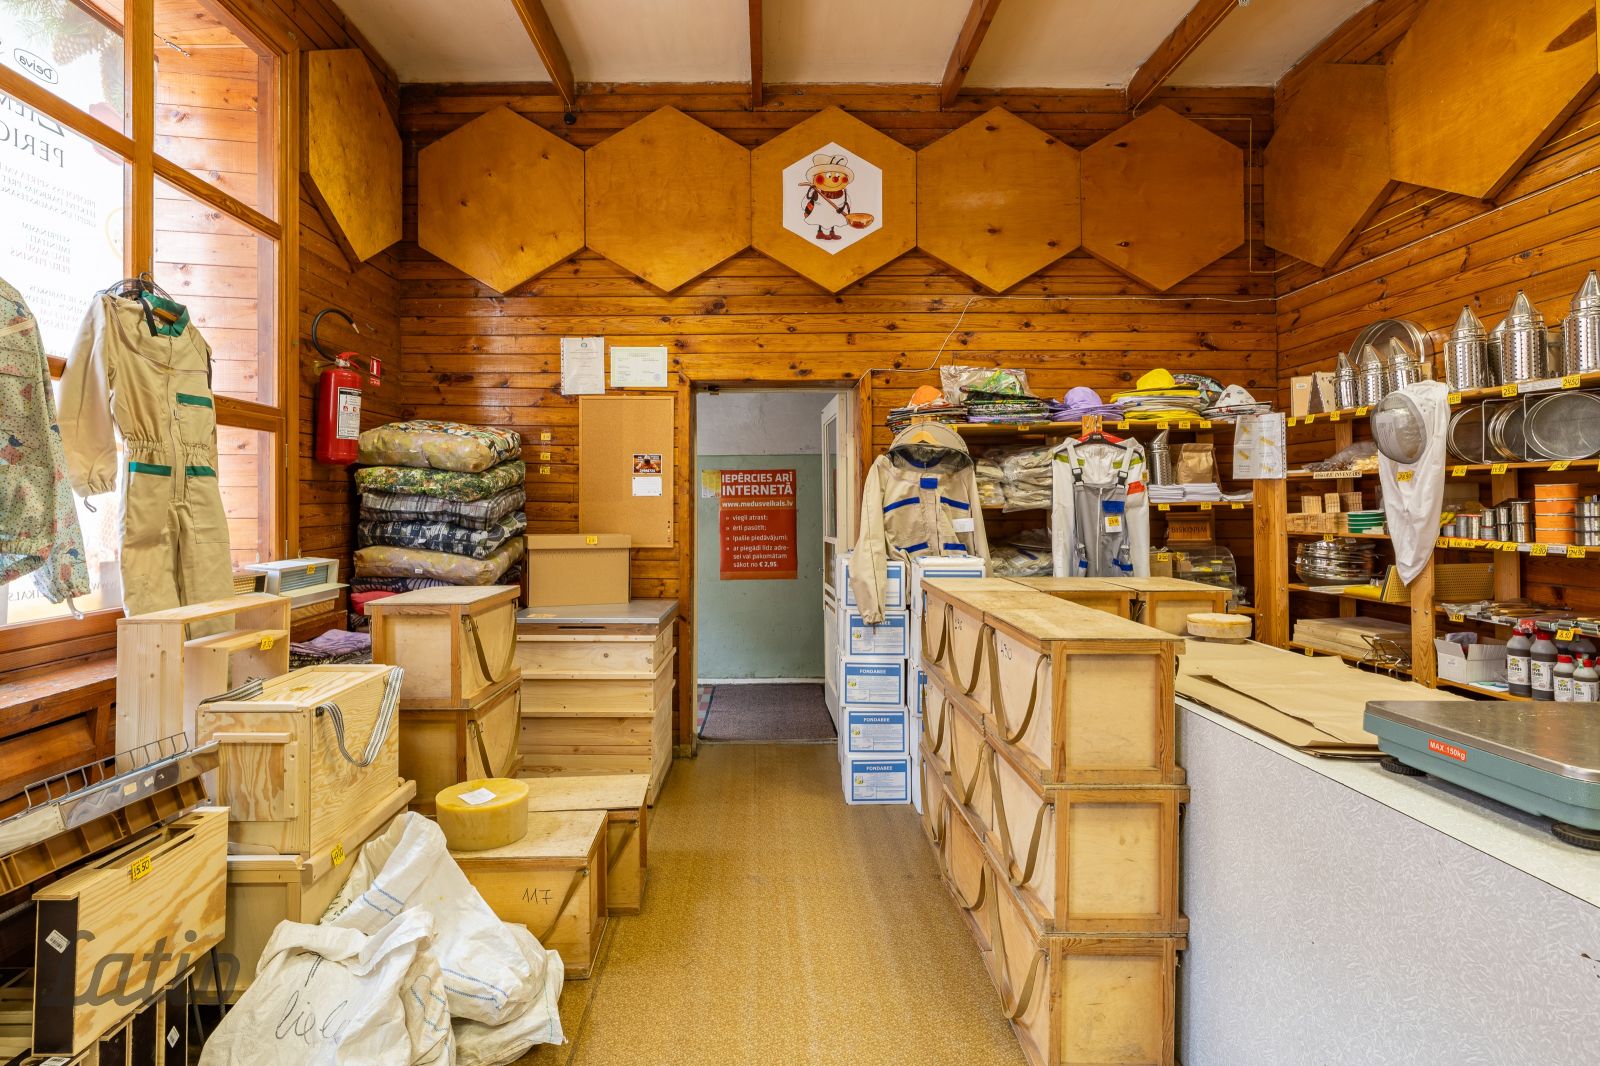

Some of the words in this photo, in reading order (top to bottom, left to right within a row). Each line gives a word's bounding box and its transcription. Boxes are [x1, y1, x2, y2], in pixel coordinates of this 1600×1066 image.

[722, 472, 772, 483] IEPĒRCIES
[775, 471, 793, 482] ARĪ
[722, 482, 793, 496] INTERNETĀ
[722, 500, 793, 508] www.medusveikals.lv
